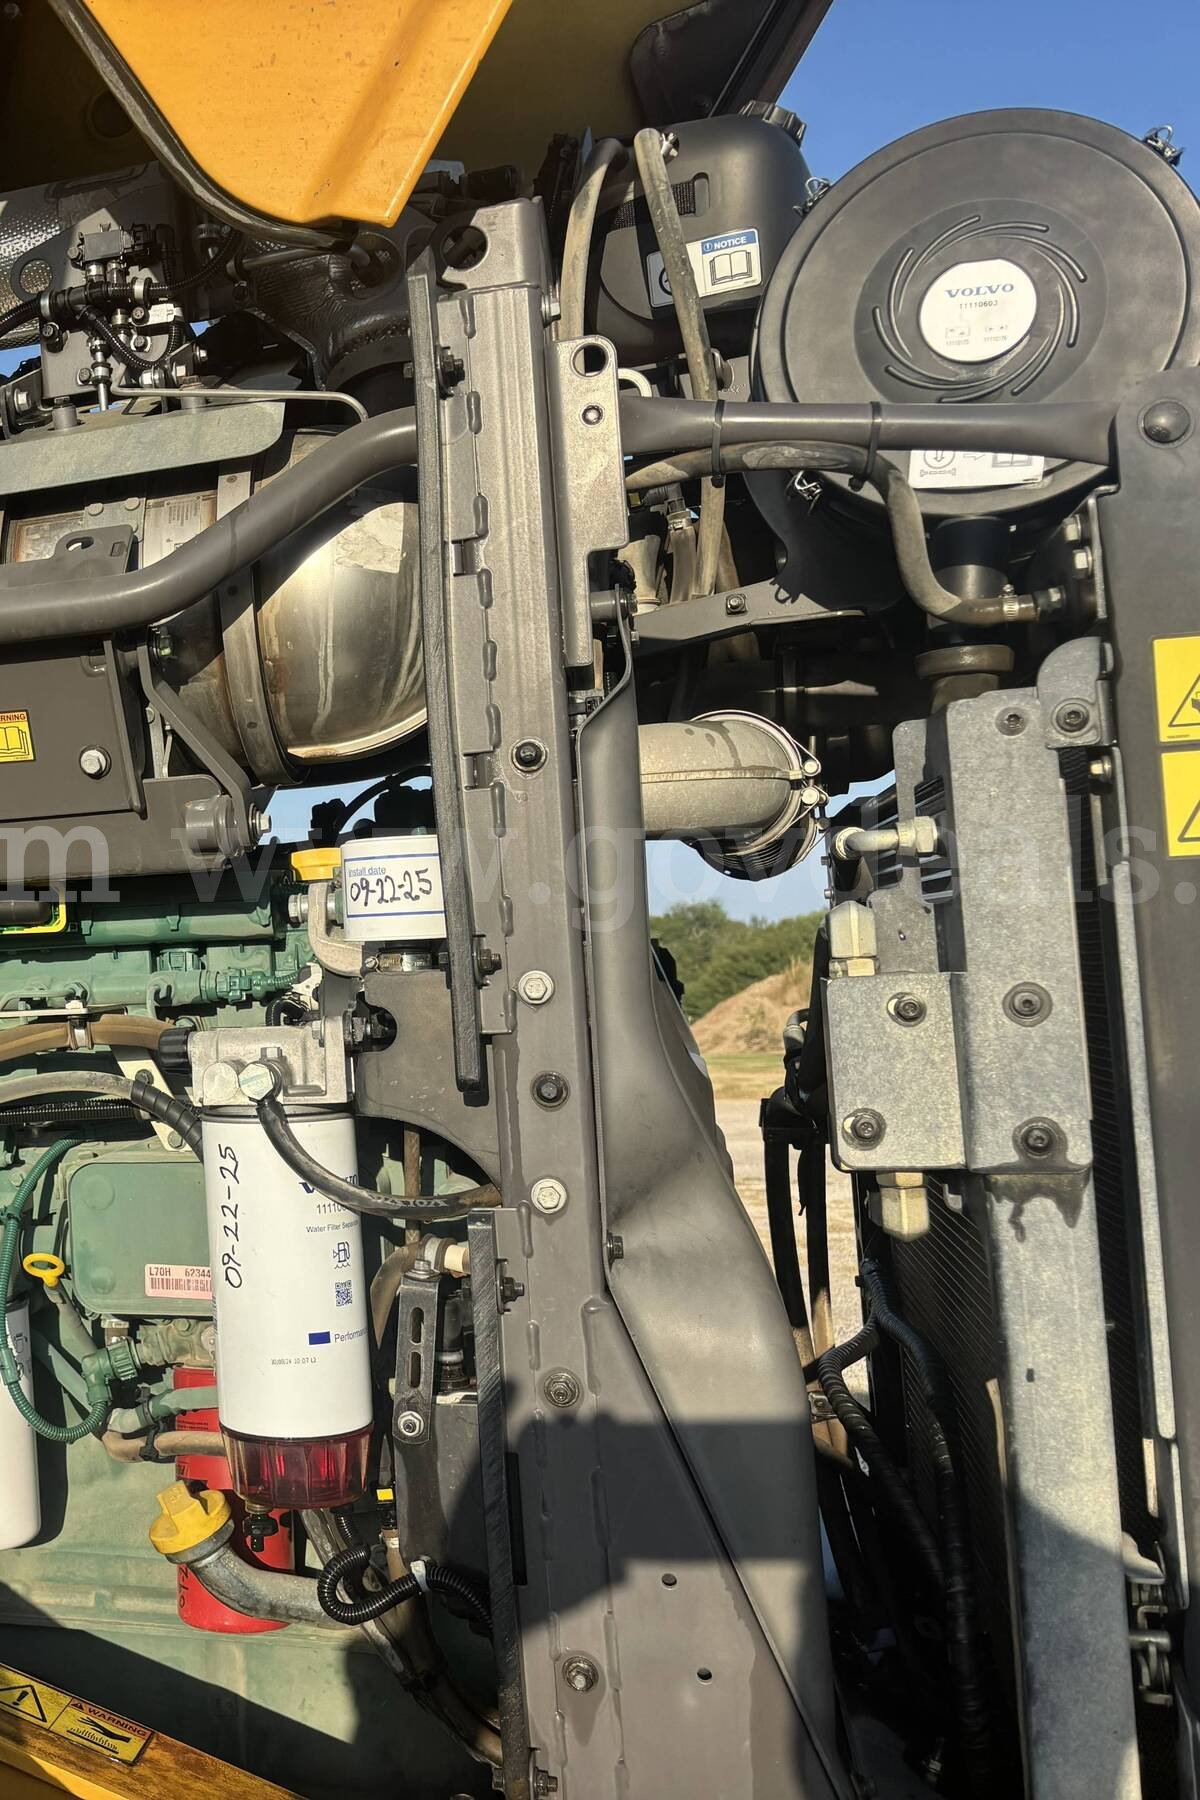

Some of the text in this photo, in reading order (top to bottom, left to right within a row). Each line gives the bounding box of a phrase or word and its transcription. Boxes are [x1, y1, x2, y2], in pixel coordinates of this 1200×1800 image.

[713, 235, 747, 250] NOTICE
[944, 283, 1015, 298] VOLVO
[368, 866, 387, 876] date
[350, 868, 433, 907] 09-22-25
[217, 1143, 244, 1289] 09-22-25
[306, 1225, 326, 1234] Water
[149, 1267, 172, 1277] L70H
[87, 1706, 148, 1738] WARNING
